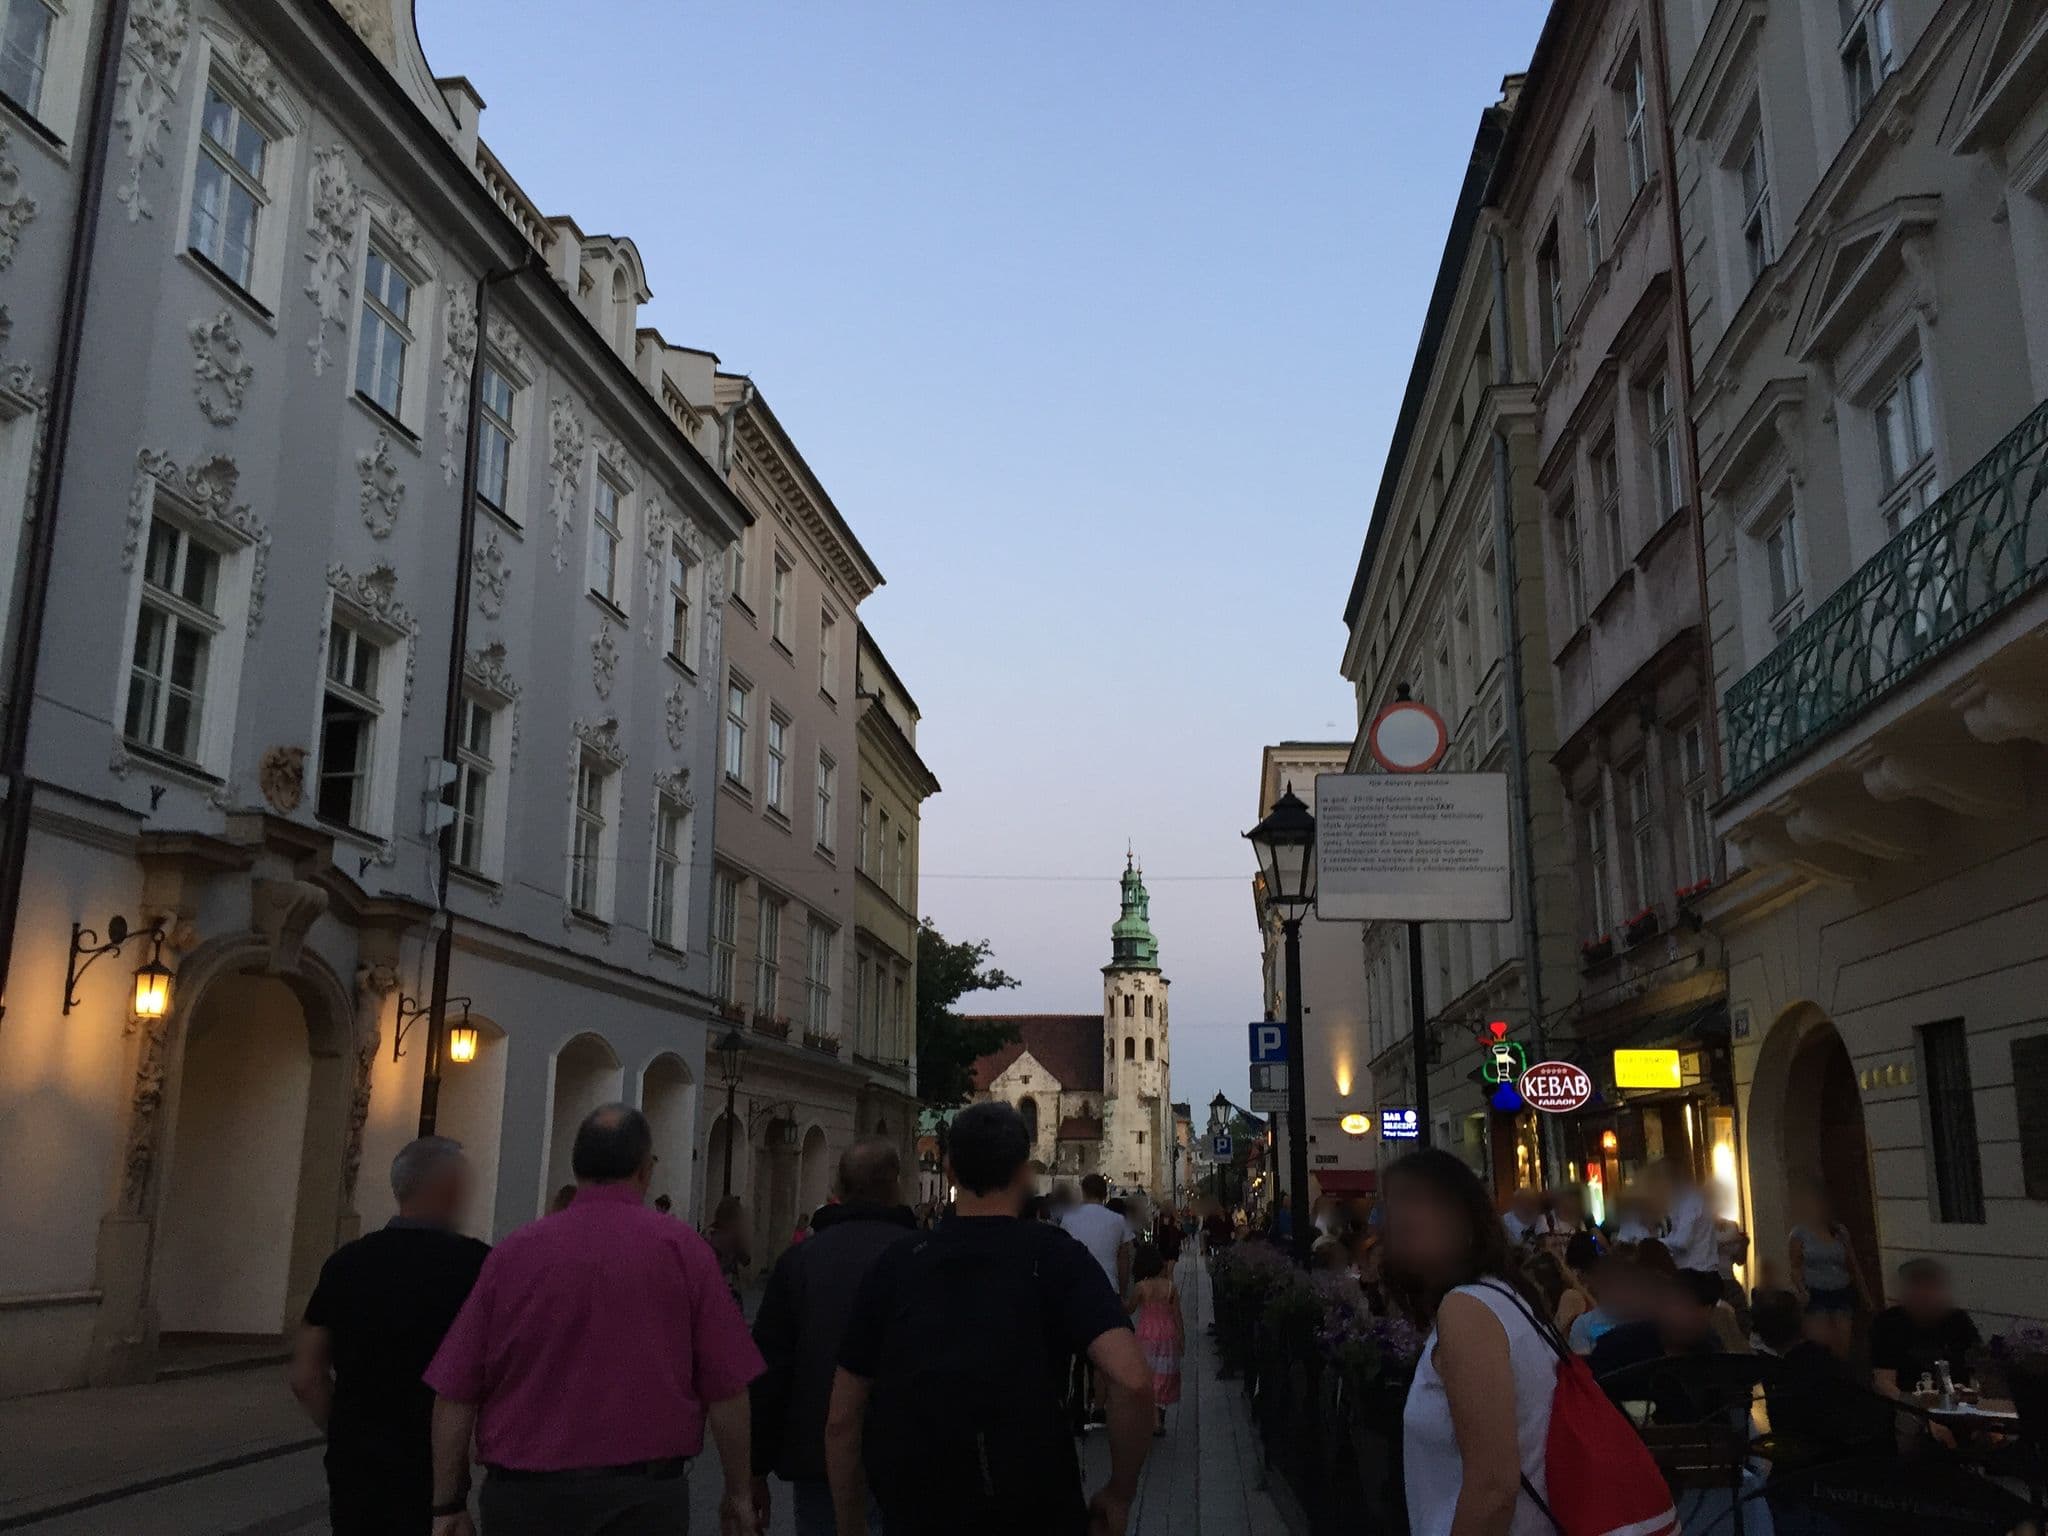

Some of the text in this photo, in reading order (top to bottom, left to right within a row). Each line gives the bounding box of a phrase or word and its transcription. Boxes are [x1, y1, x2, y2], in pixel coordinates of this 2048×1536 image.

[1258, 1026, 1281, 1059] P
[1524, 1075, 1588, 1097] KEBAB
[1538, 1098, 1576, 1106] FARAON
[1383, 1112, 1401, 1121] BAR
[1216, 1138, 1227, 1152] P
